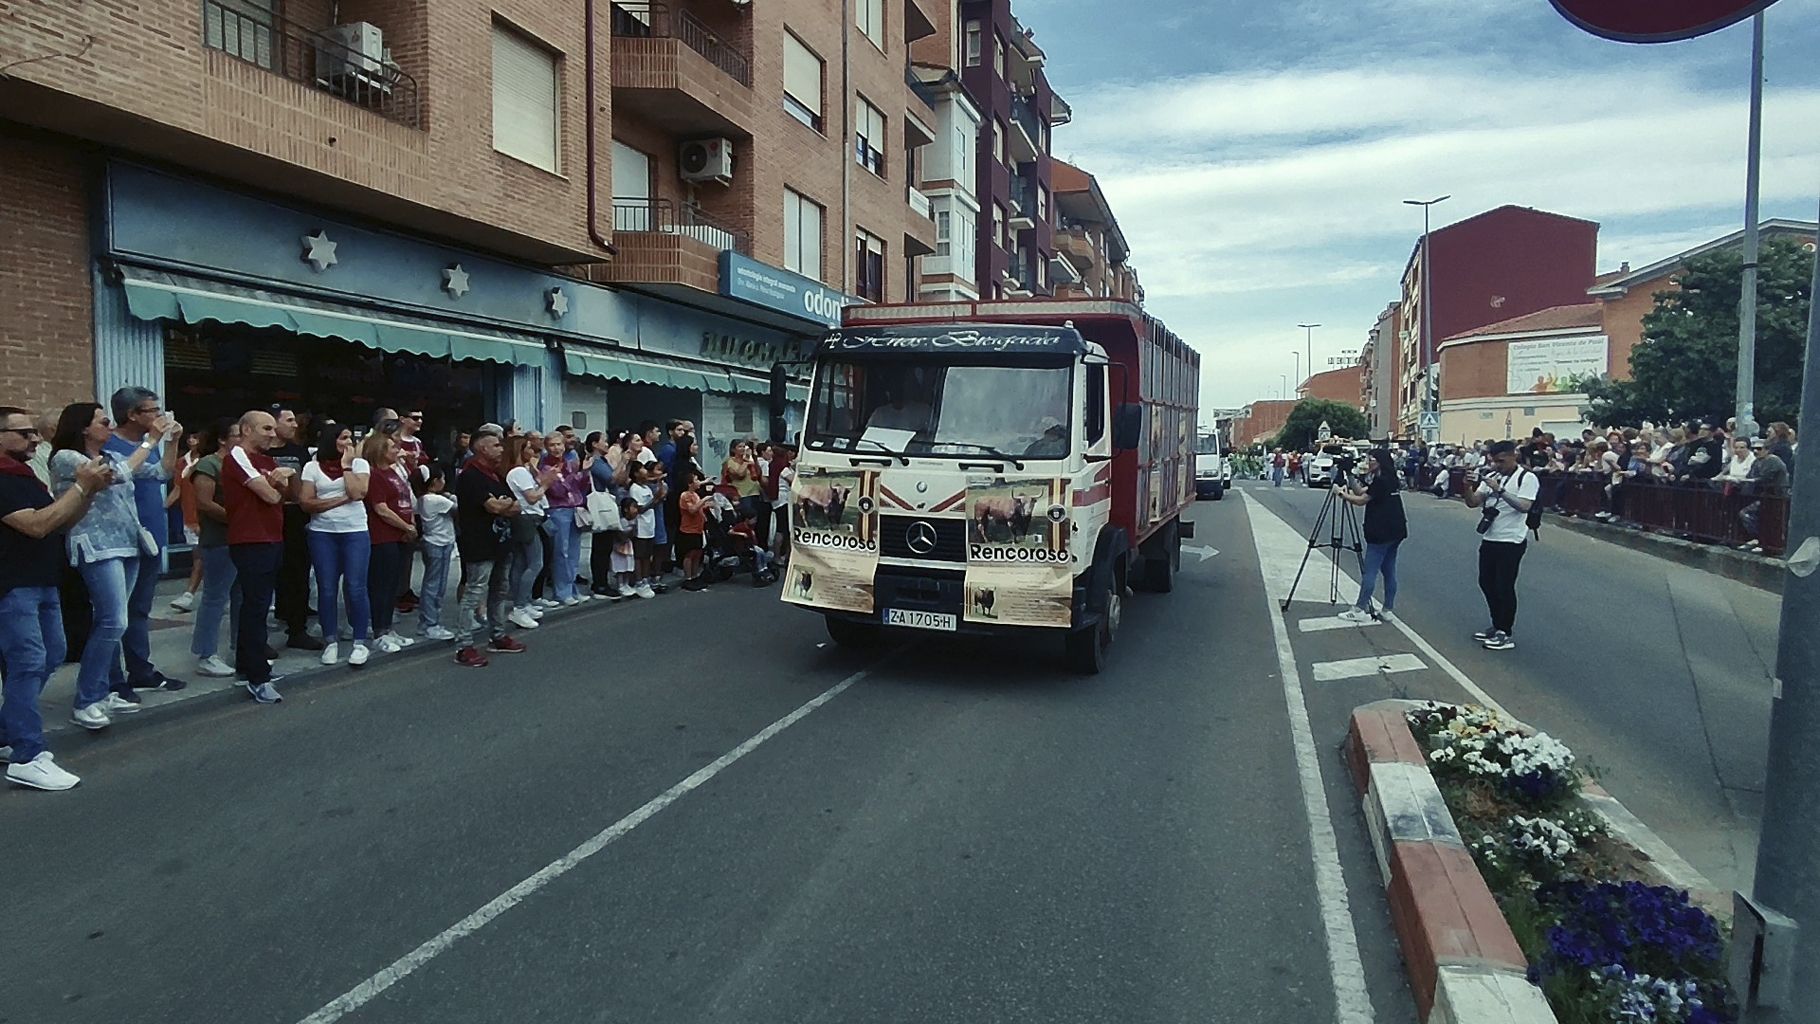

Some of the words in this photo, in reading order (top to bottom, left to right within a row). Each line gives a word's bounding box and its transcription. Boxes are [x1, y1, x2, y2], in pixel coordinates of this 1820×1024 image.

[804, 287, 850, 321] odon
[794, 526, 877, 551] Rencoroso
[970, 542, 1069, 562] Rencoroso
